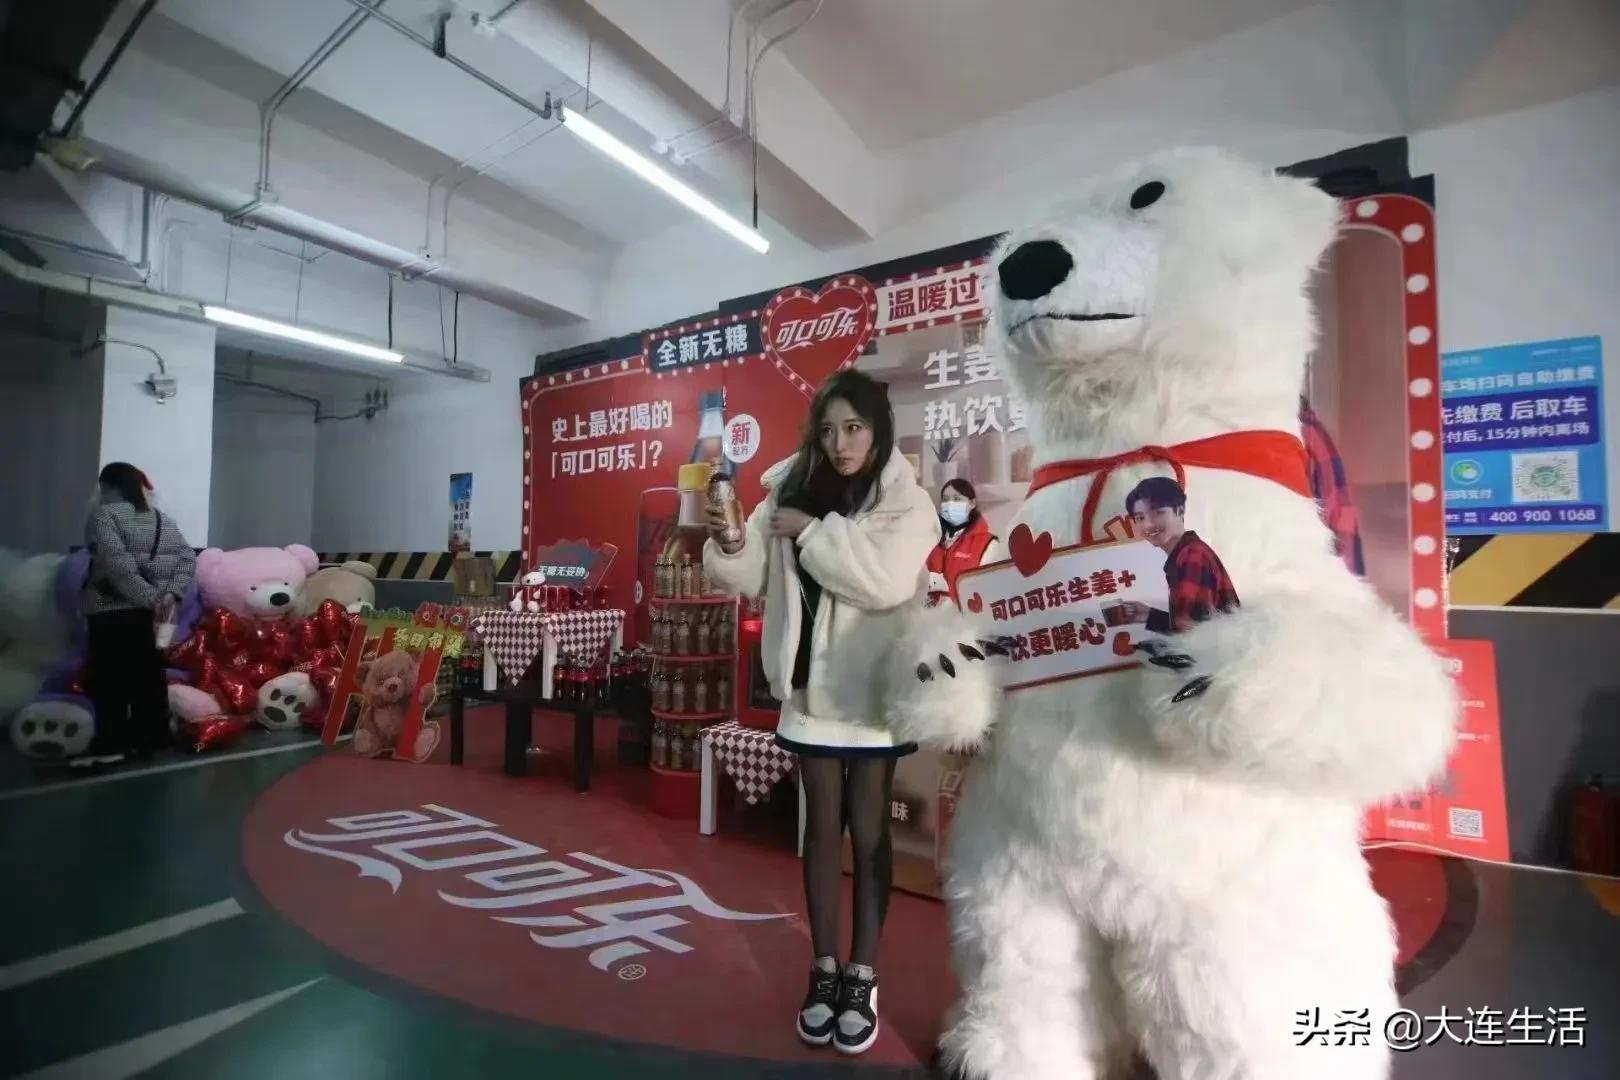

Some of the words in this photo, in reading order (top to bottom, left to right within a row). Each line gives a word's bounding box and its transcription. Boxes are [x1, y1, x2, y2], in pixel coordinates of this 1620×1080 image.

[888, 273, 991, 321] 温暖过
[657, 324, 748, 367] 全新无糖
[776, 303, 864, 352] 可口可乐
[552, 399, 673, 443] 史上最好喝的
[1510, 396, 1588, 420] 后取车
[732, 421, 750, 445] 新
[1489, 511, 1517, 522] 400
[1523, 510, 1551, 522] 900
[1559, 509, 1596, 521] 1068
[284, 804, 799, 971] 可口可乐
